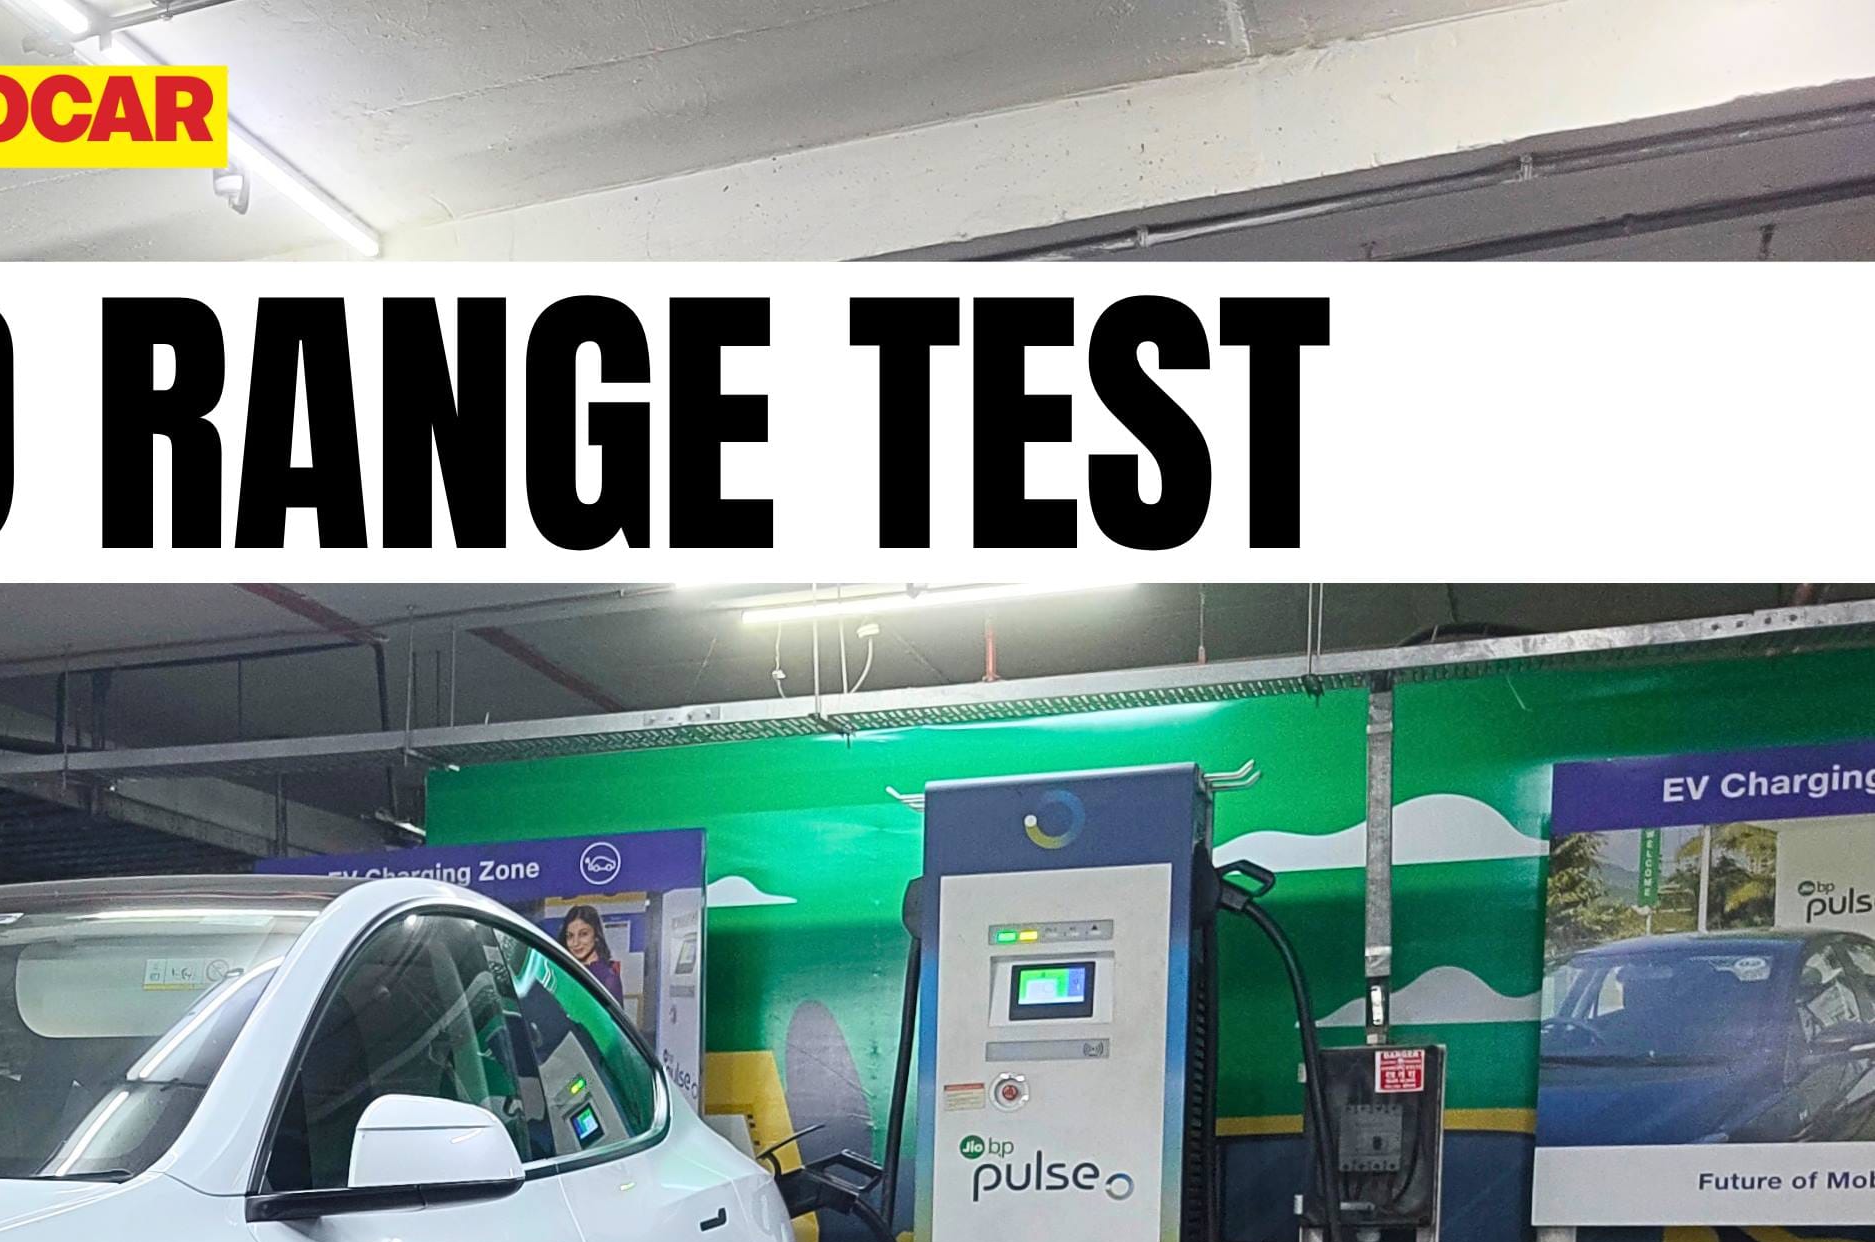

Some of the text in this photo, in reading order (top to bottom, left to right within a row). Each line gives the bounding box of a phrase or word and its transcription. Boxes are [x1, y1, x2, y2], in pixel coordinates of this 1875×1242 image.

[1663, 775, 1709, 803] EV
[478, 860, 540, 882] Zone
[1816, 880, 1836, 895] bp
[1806, 887, 1875, 924] puls
[988, 1136, 1015, 1159] bp
[972, 1149, 1101, 1202] pulse
[1698, 1172, 1783, 1190] Future
[1791, 1171, 1819, 1190] of
